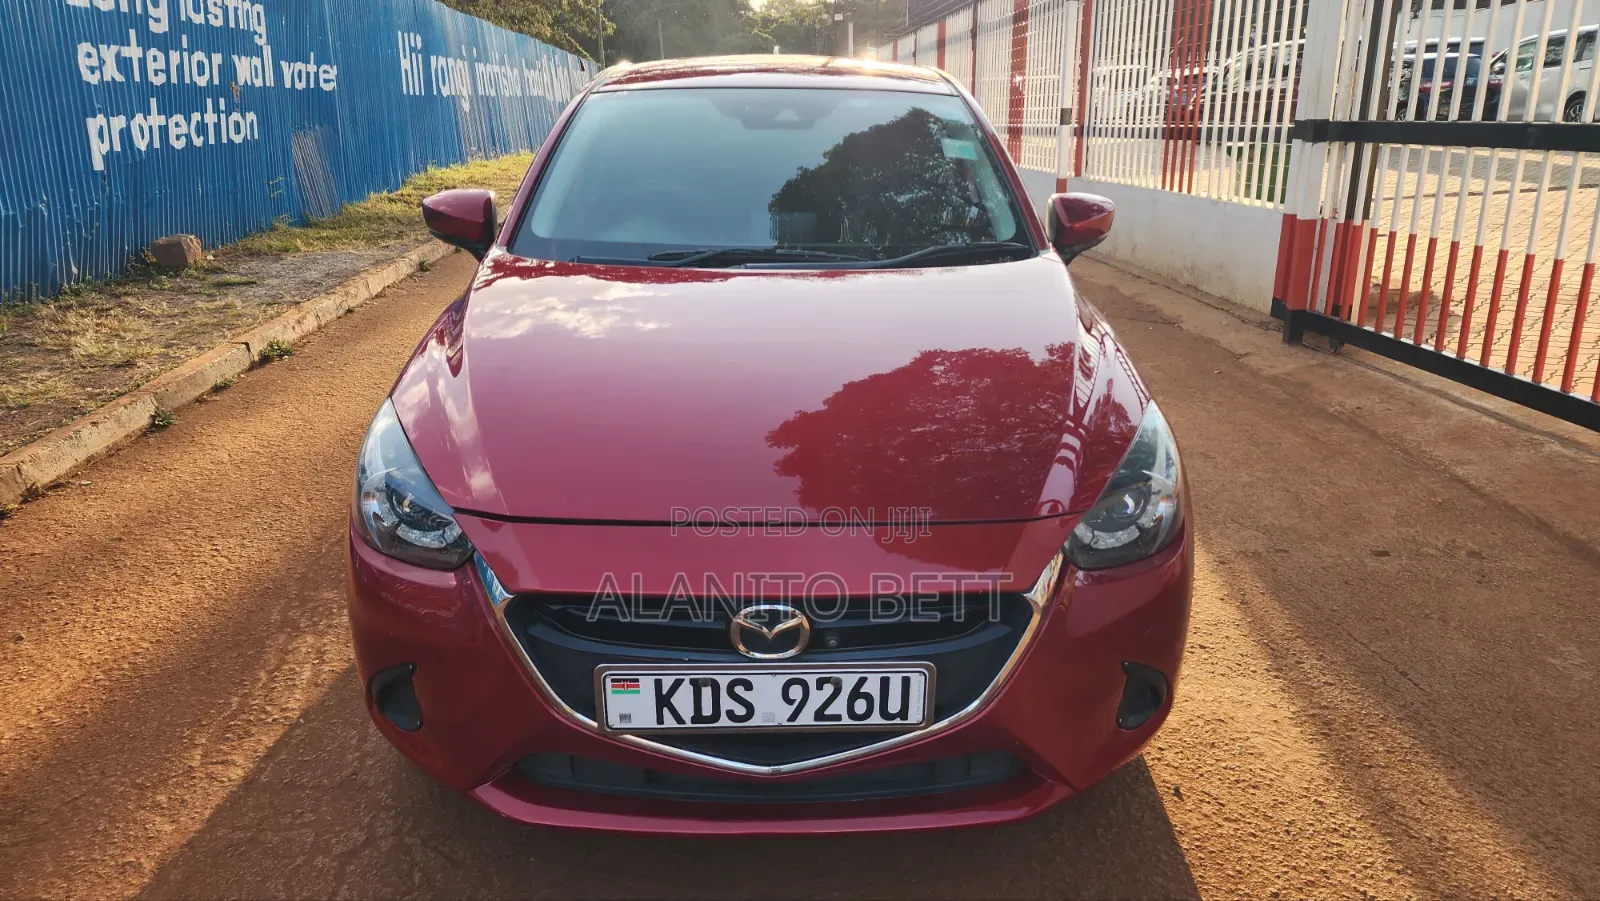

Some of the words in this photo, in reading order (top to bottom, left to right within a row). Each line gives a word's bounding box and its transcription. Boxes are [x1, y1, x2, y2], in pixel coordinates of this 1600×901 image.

[77, 29, 222, 86] exterior
[231, 44, 274, 87] wall
[398, 31, 424, 96] Hii
[430, 45, 471, 112] rangi
[86, 98, 258, 170] protection
[654, 677, 755, 725] KDS
[781, 676, 911, 722] 926U
